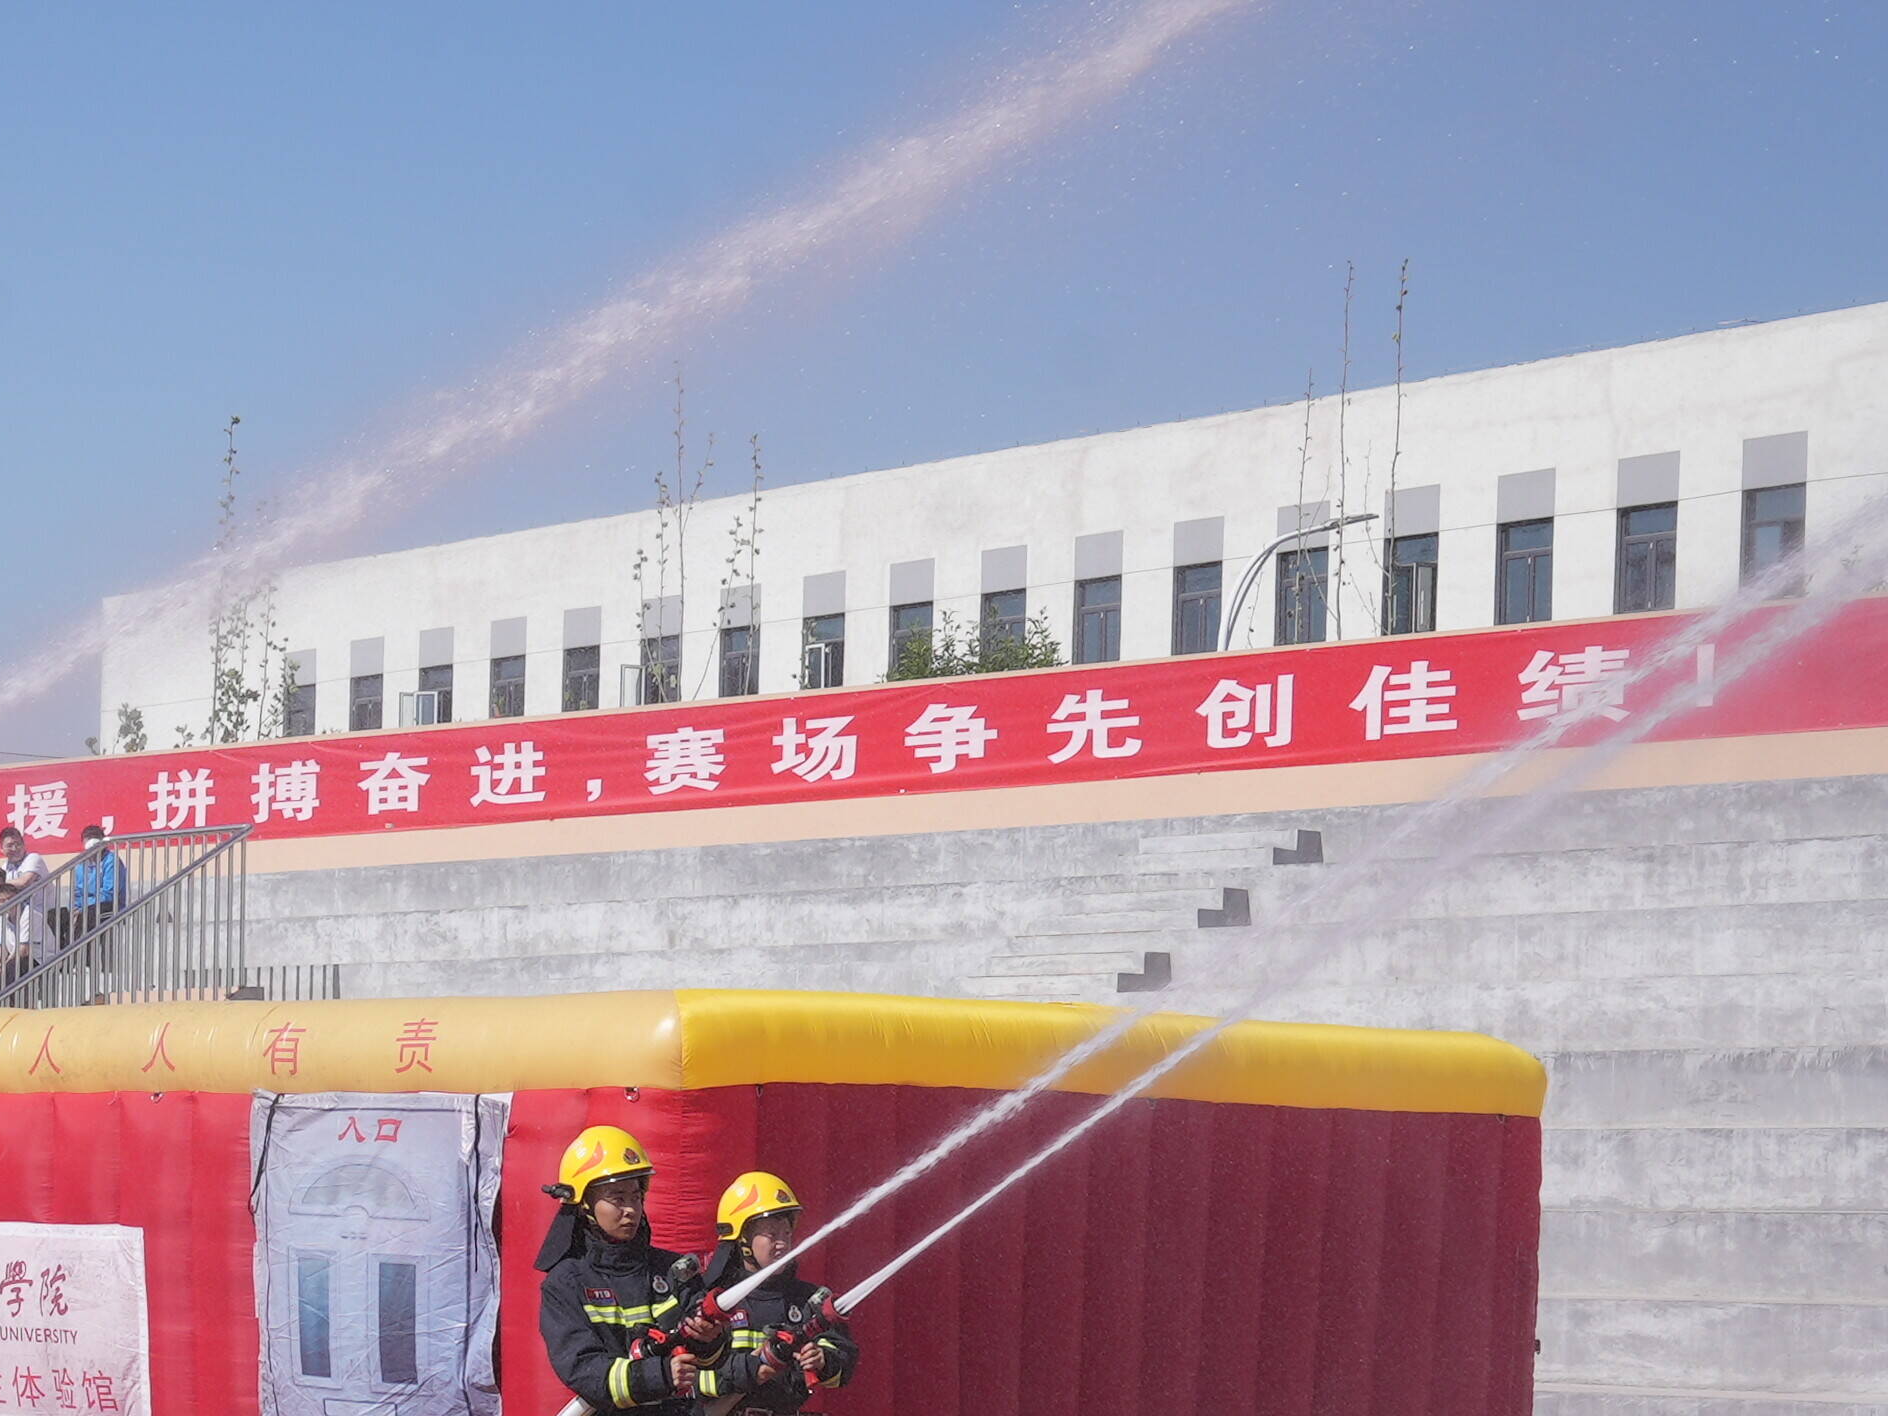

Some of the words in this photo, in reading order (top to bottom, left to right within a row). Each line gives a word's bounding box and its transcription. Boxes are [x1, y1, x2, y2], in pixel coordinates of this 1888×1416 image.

[28, 1018, 440, 1076] 人人有责
[337, 1116, 402, 1143] 入口
[0, 1326, 78, 1344] UNIVERSITY
